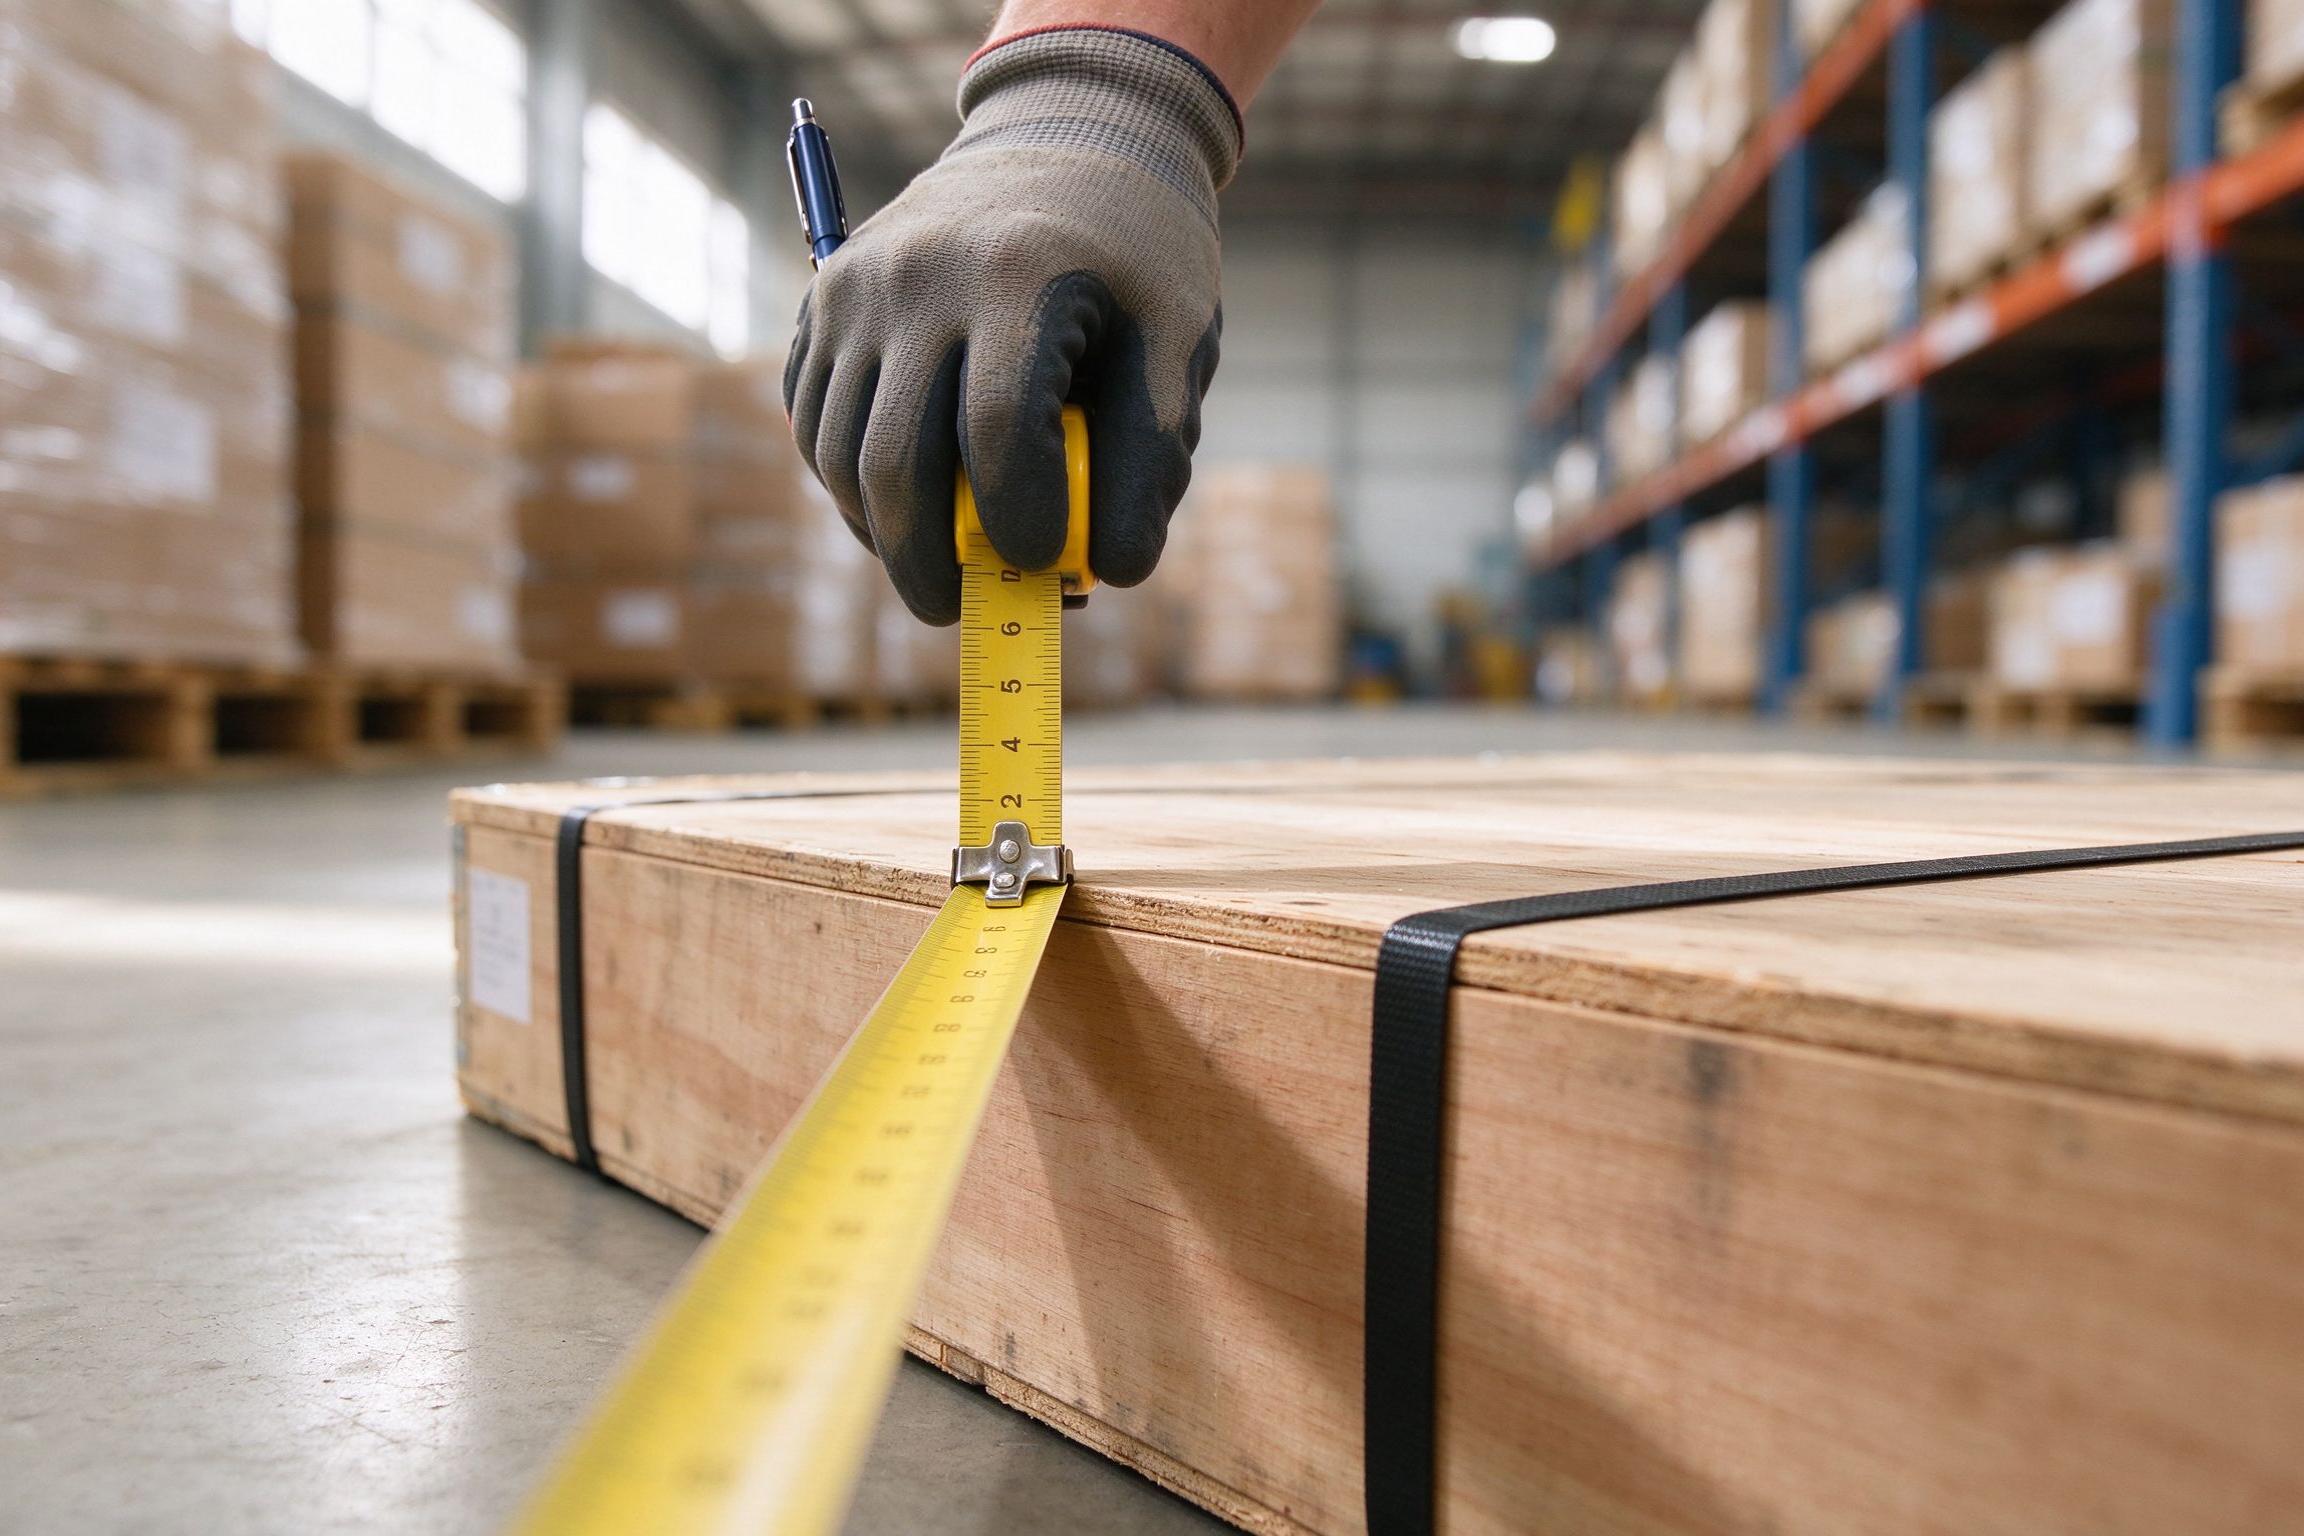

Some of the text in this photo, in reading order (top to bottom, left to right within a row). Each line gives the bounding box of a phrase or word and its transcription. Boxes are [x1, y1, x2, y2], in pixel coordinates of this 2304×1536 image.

[1001, 622, 1021, 636] 6
[1001, 680, 1021, 693] 5
[1001, 736, 1021, 752] 4
[1001, 794, 1021, 808] 2
